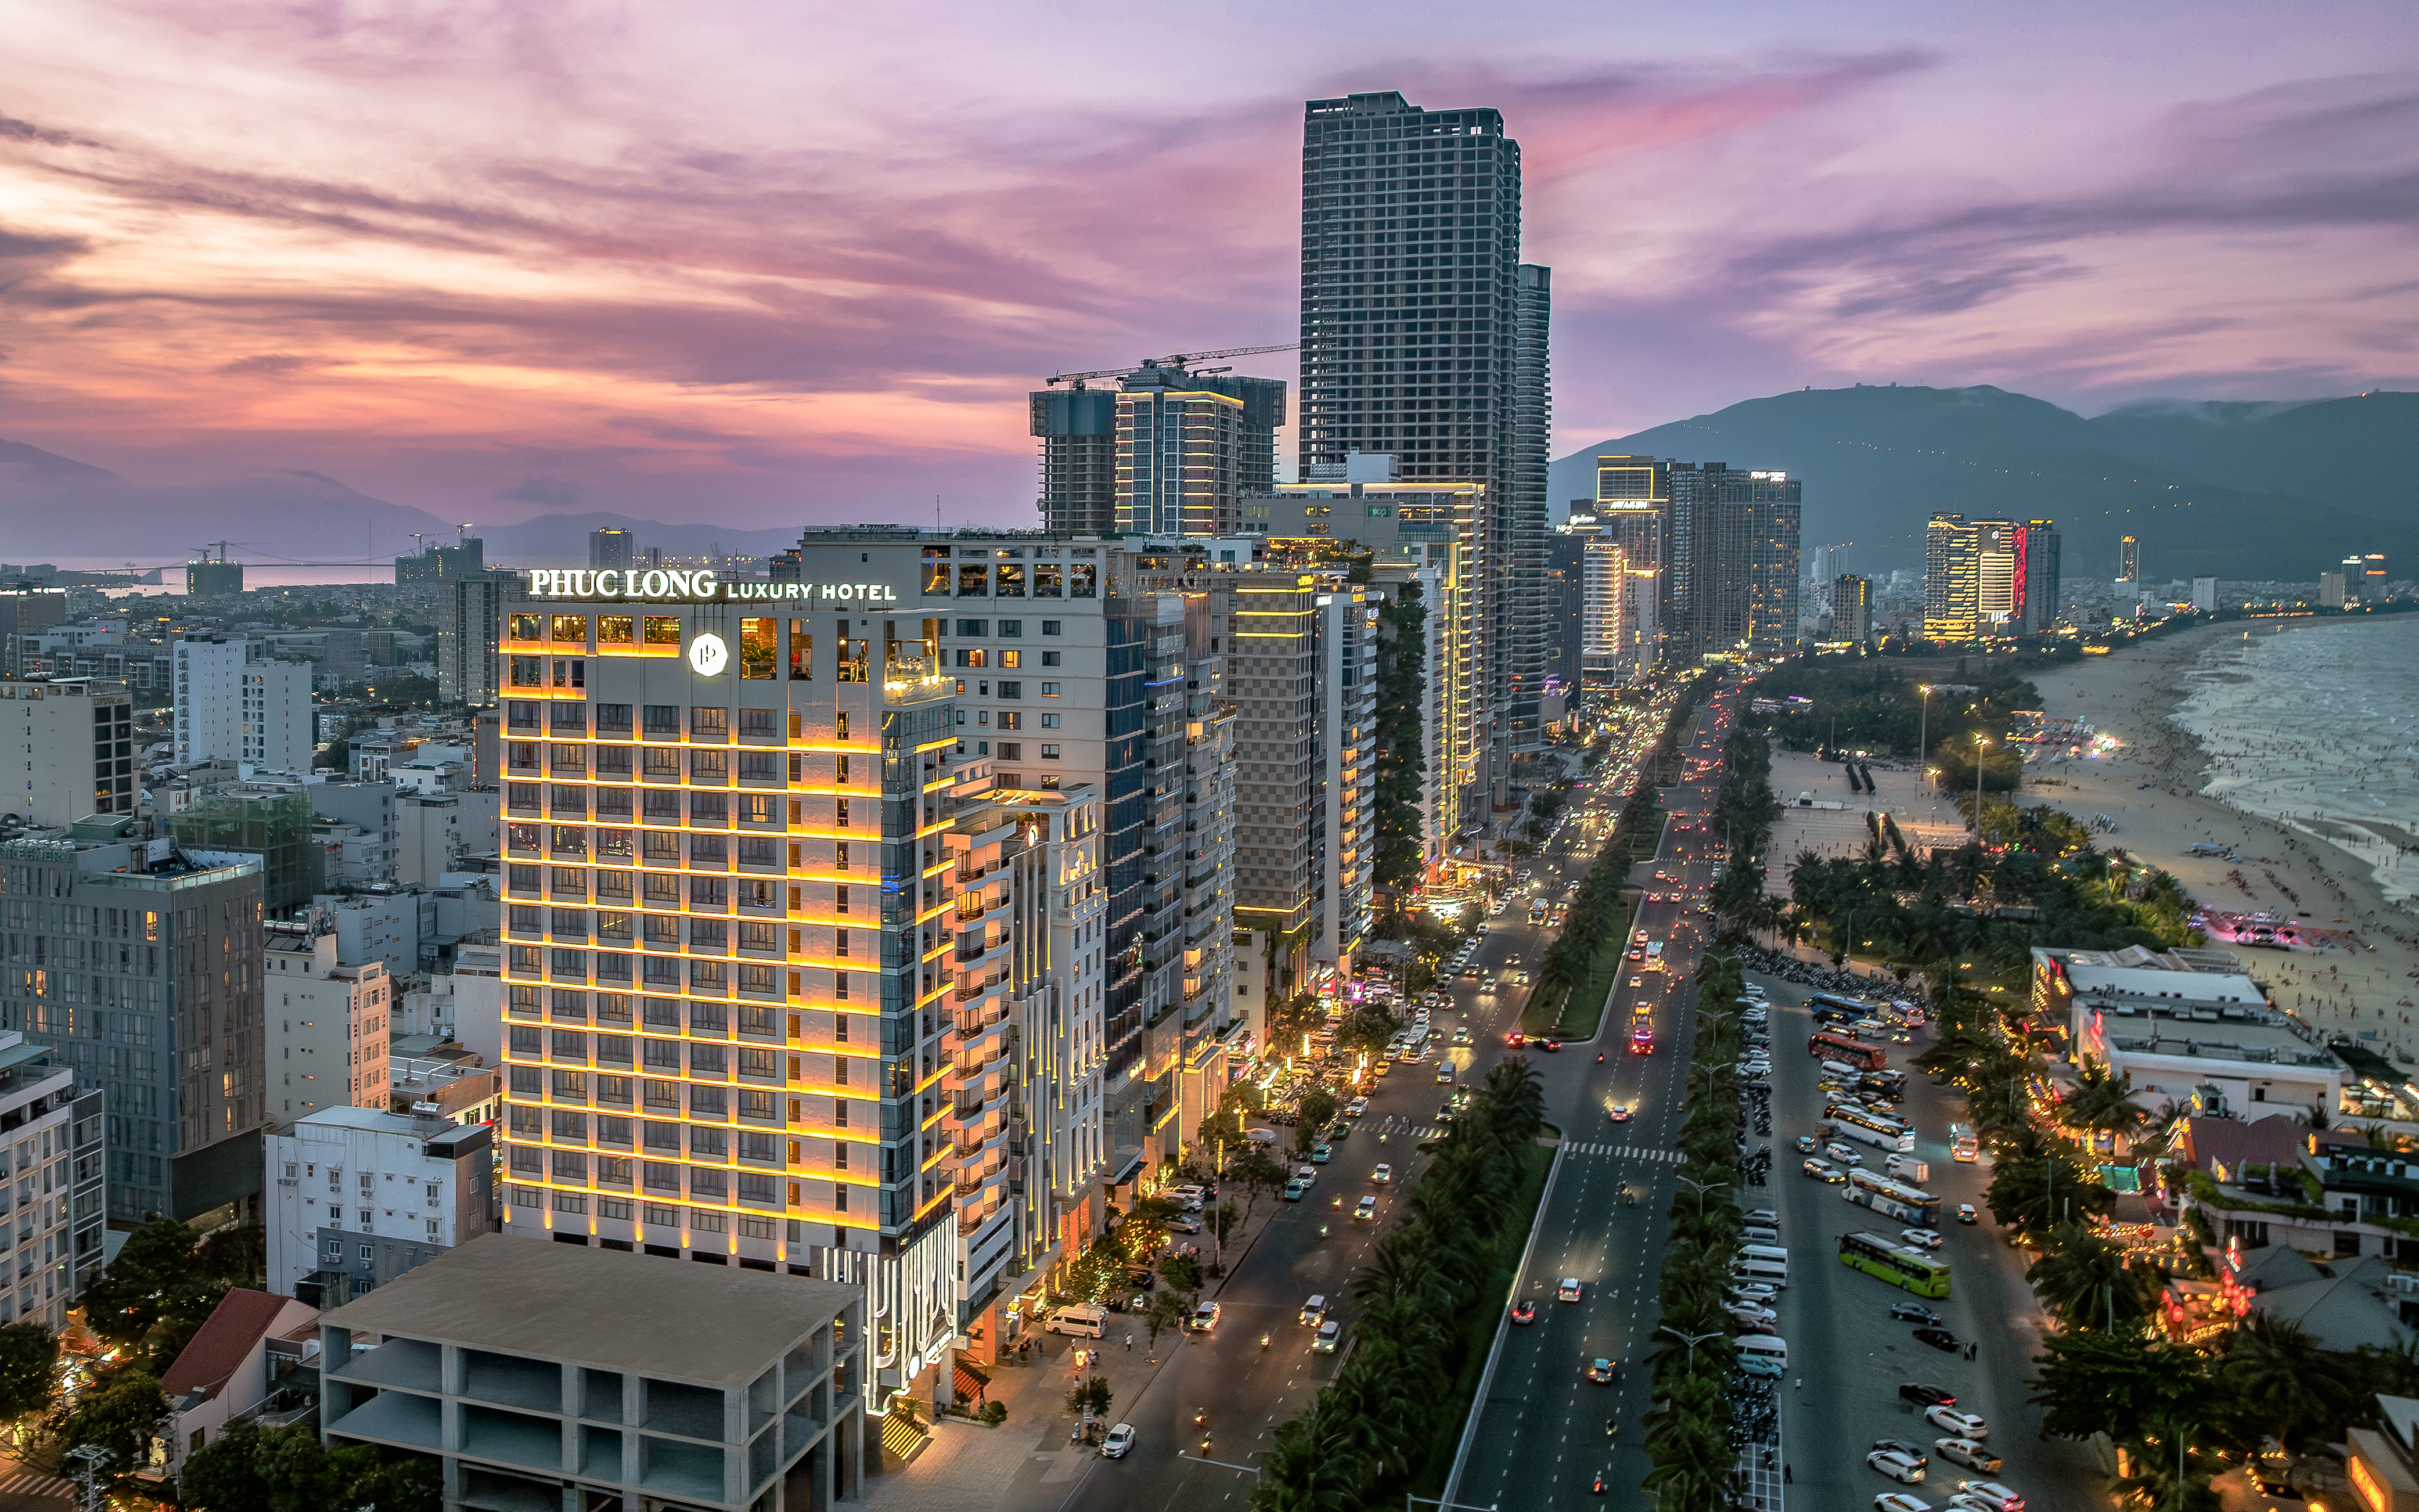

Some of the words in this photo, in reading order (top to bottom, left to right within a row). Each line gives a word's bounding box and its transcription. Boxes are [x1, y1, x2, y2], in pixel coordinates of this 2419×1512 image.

[528, 569, 618, 596] PHUC
[624, 570, 718, 597] LONG
[727, 583, 813, 599] LUXURY
[822, 584, 897, 601] HOTEL
